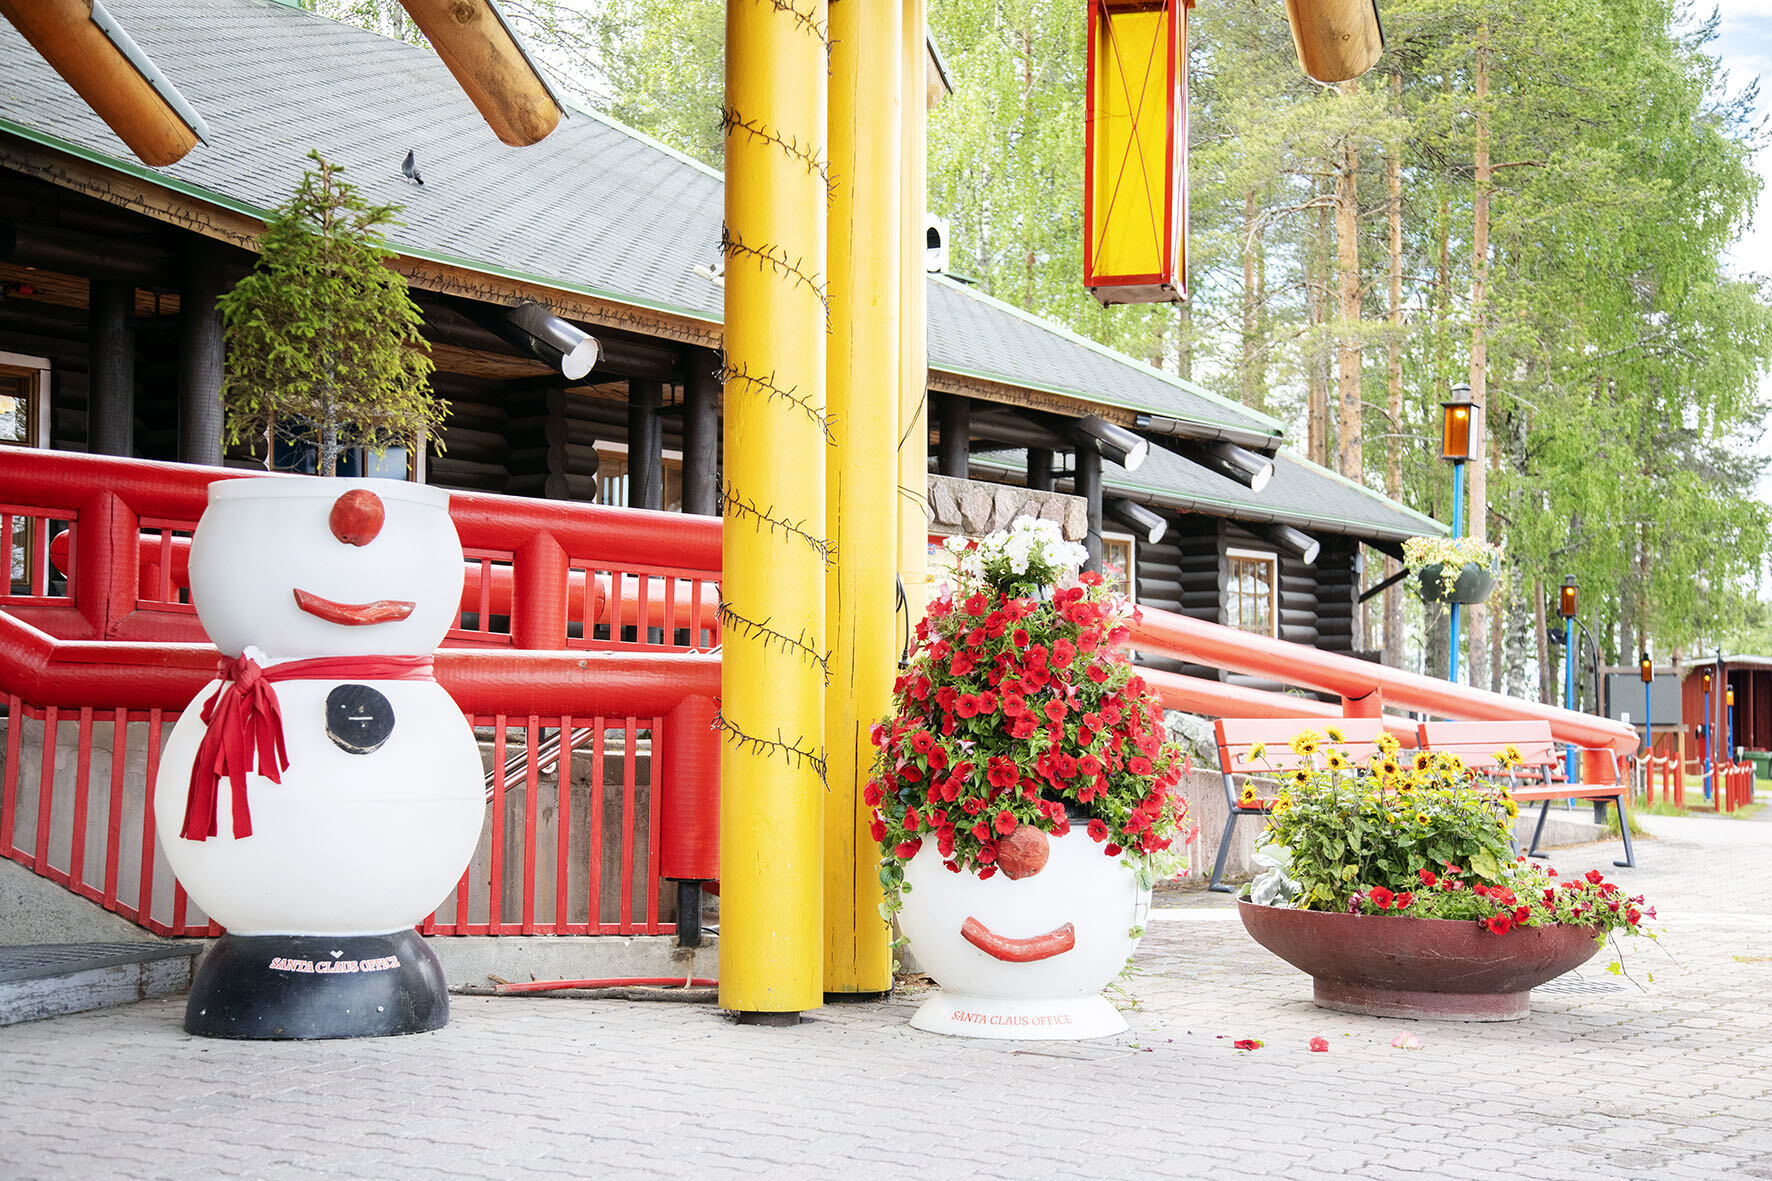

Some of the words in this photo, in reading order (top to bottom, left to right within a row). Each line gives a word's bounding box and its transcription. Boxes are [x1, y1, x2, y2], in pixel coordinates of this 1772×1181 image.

[269, 957, 315, 973] SANTA
[315, 960, 360, 974] CLAUS
[359, 955, 401, 972] OFFICE
[952, 1010, 987, 1025] SANTA
[990, 1015, 1029, 1026] CLAUS
[1031, 1014, 1073, 1026] OFFICE
